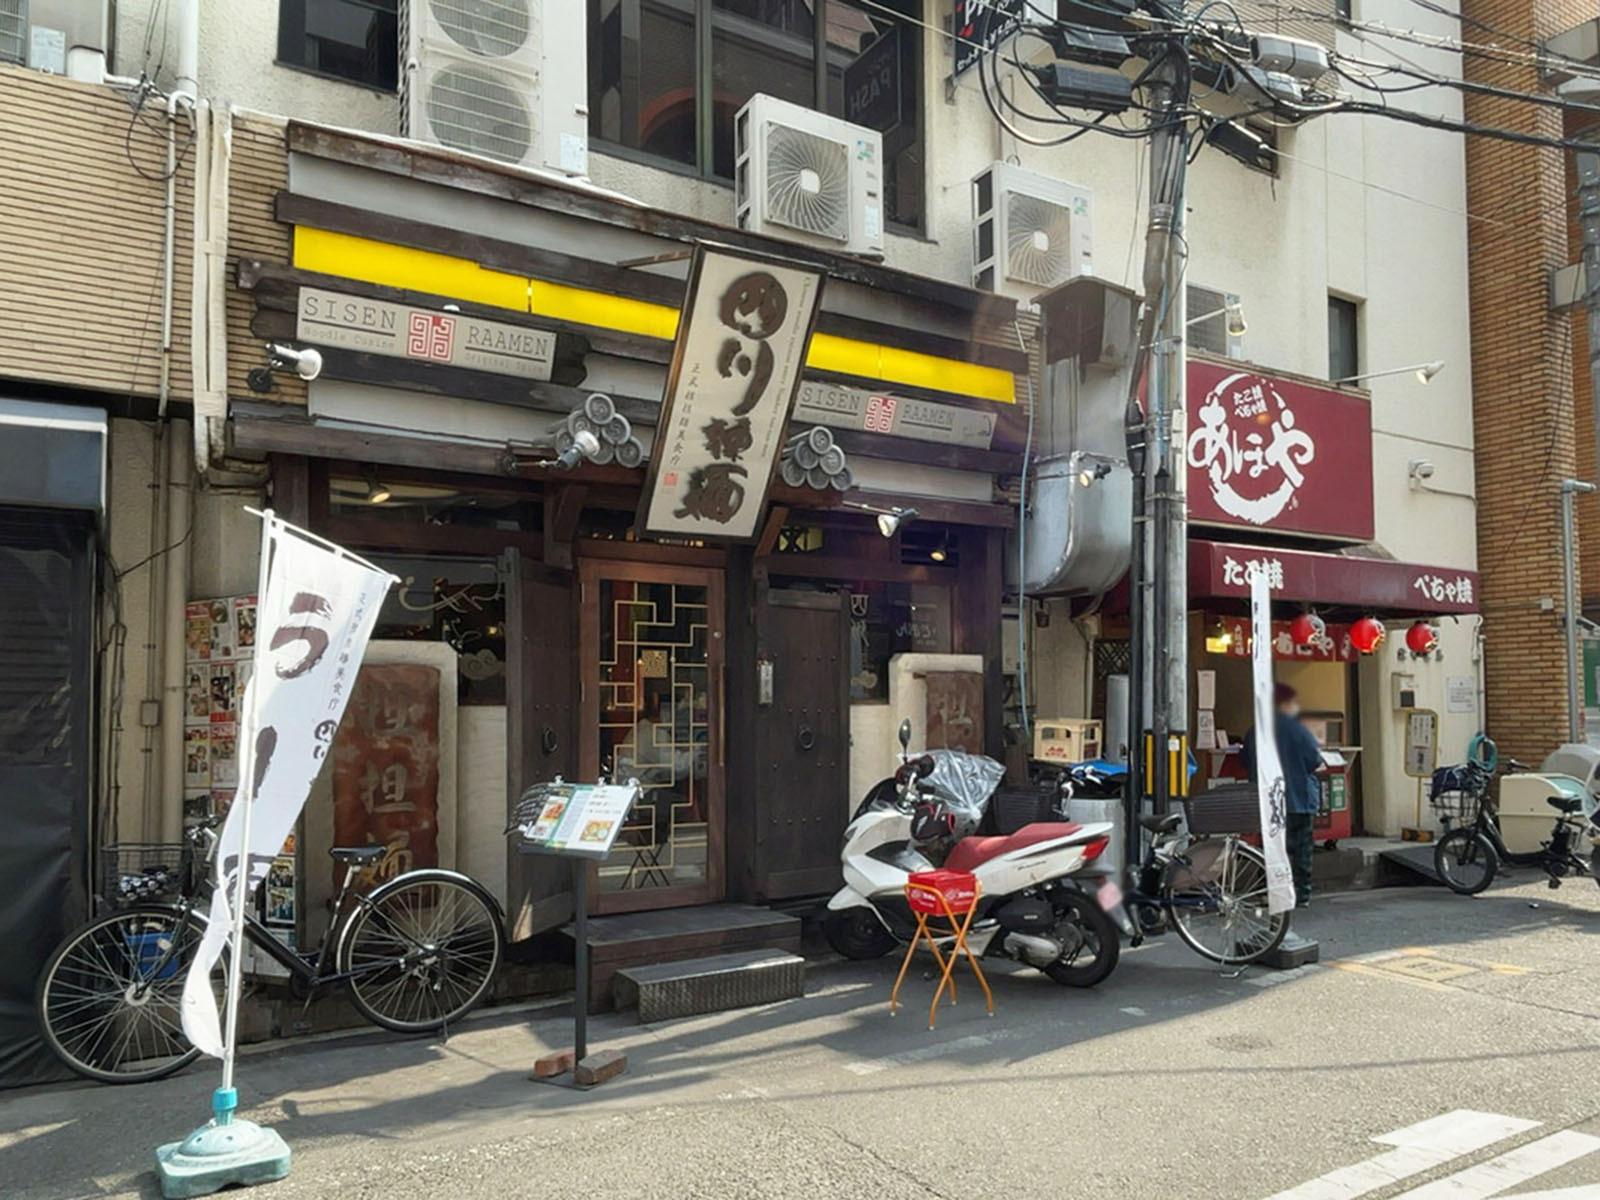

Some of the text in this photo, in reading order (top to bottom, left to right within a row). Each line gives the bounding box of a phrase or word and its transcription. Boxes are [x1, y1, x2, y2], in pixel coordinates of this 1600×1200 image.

[303, 296, 548, 356] SISEN RAAMEN
[801, 386, 956, 426] SISEN RAAMEN
